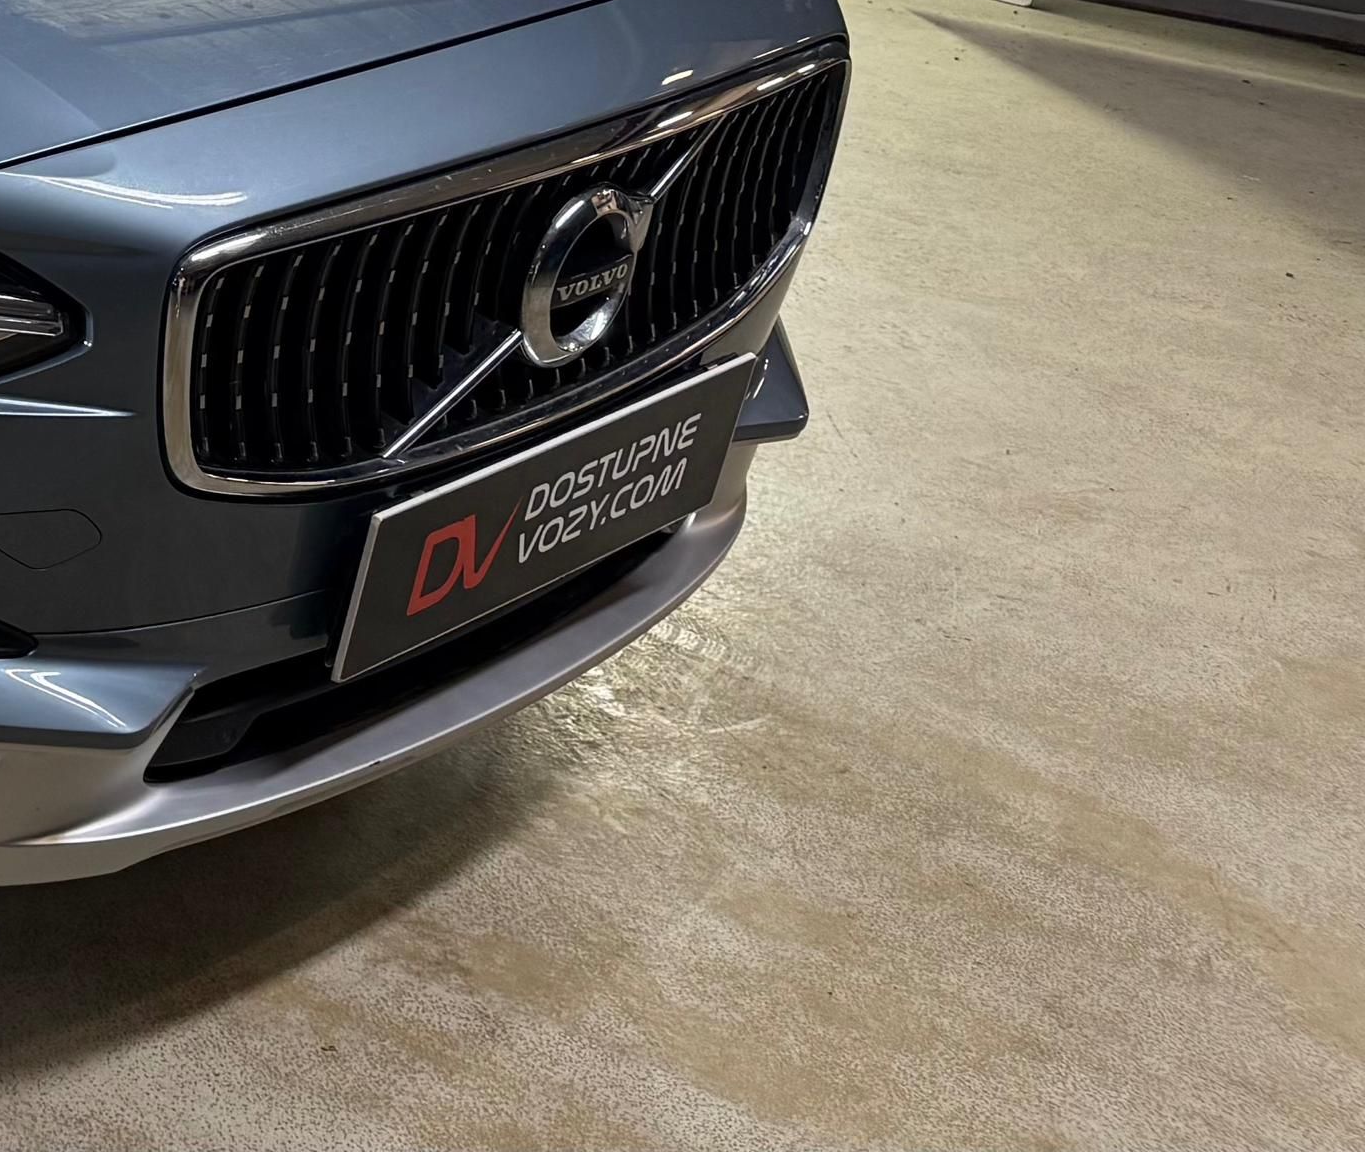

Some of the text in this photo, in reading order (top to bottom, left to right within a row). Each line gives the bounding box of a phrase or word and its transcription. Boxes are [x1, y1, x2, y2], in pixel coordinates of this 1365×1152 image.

[556, 261, 630, 303] VOLVO
[518, 456, 687, 565] VOZY.COM
[524, 412, 702, 523] DOSTUPNE
